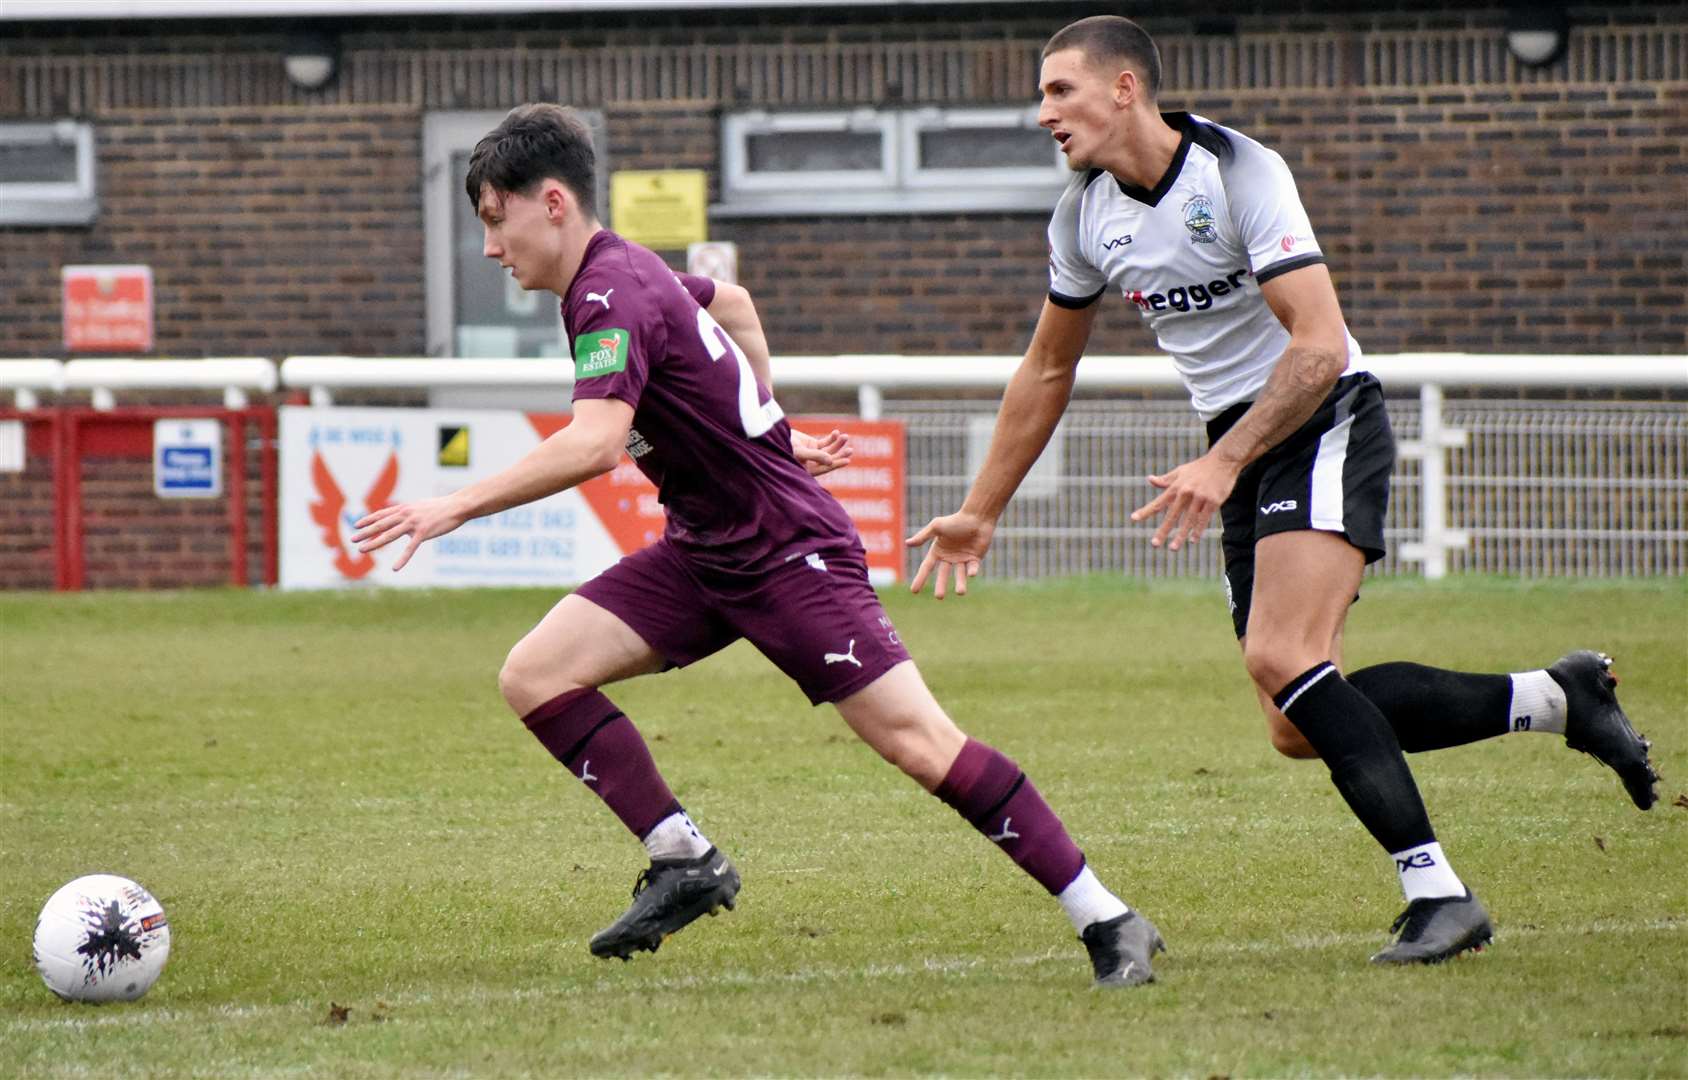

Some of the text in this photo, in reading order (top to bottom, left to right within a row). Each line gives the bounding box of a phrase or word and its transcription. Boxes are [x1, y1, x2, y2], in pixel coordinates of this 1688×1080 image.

[1103, 234, 1133, 250] VX3
[590, 348, 612, 362] FOX
[1261, 499, 1297, 515] VX3
